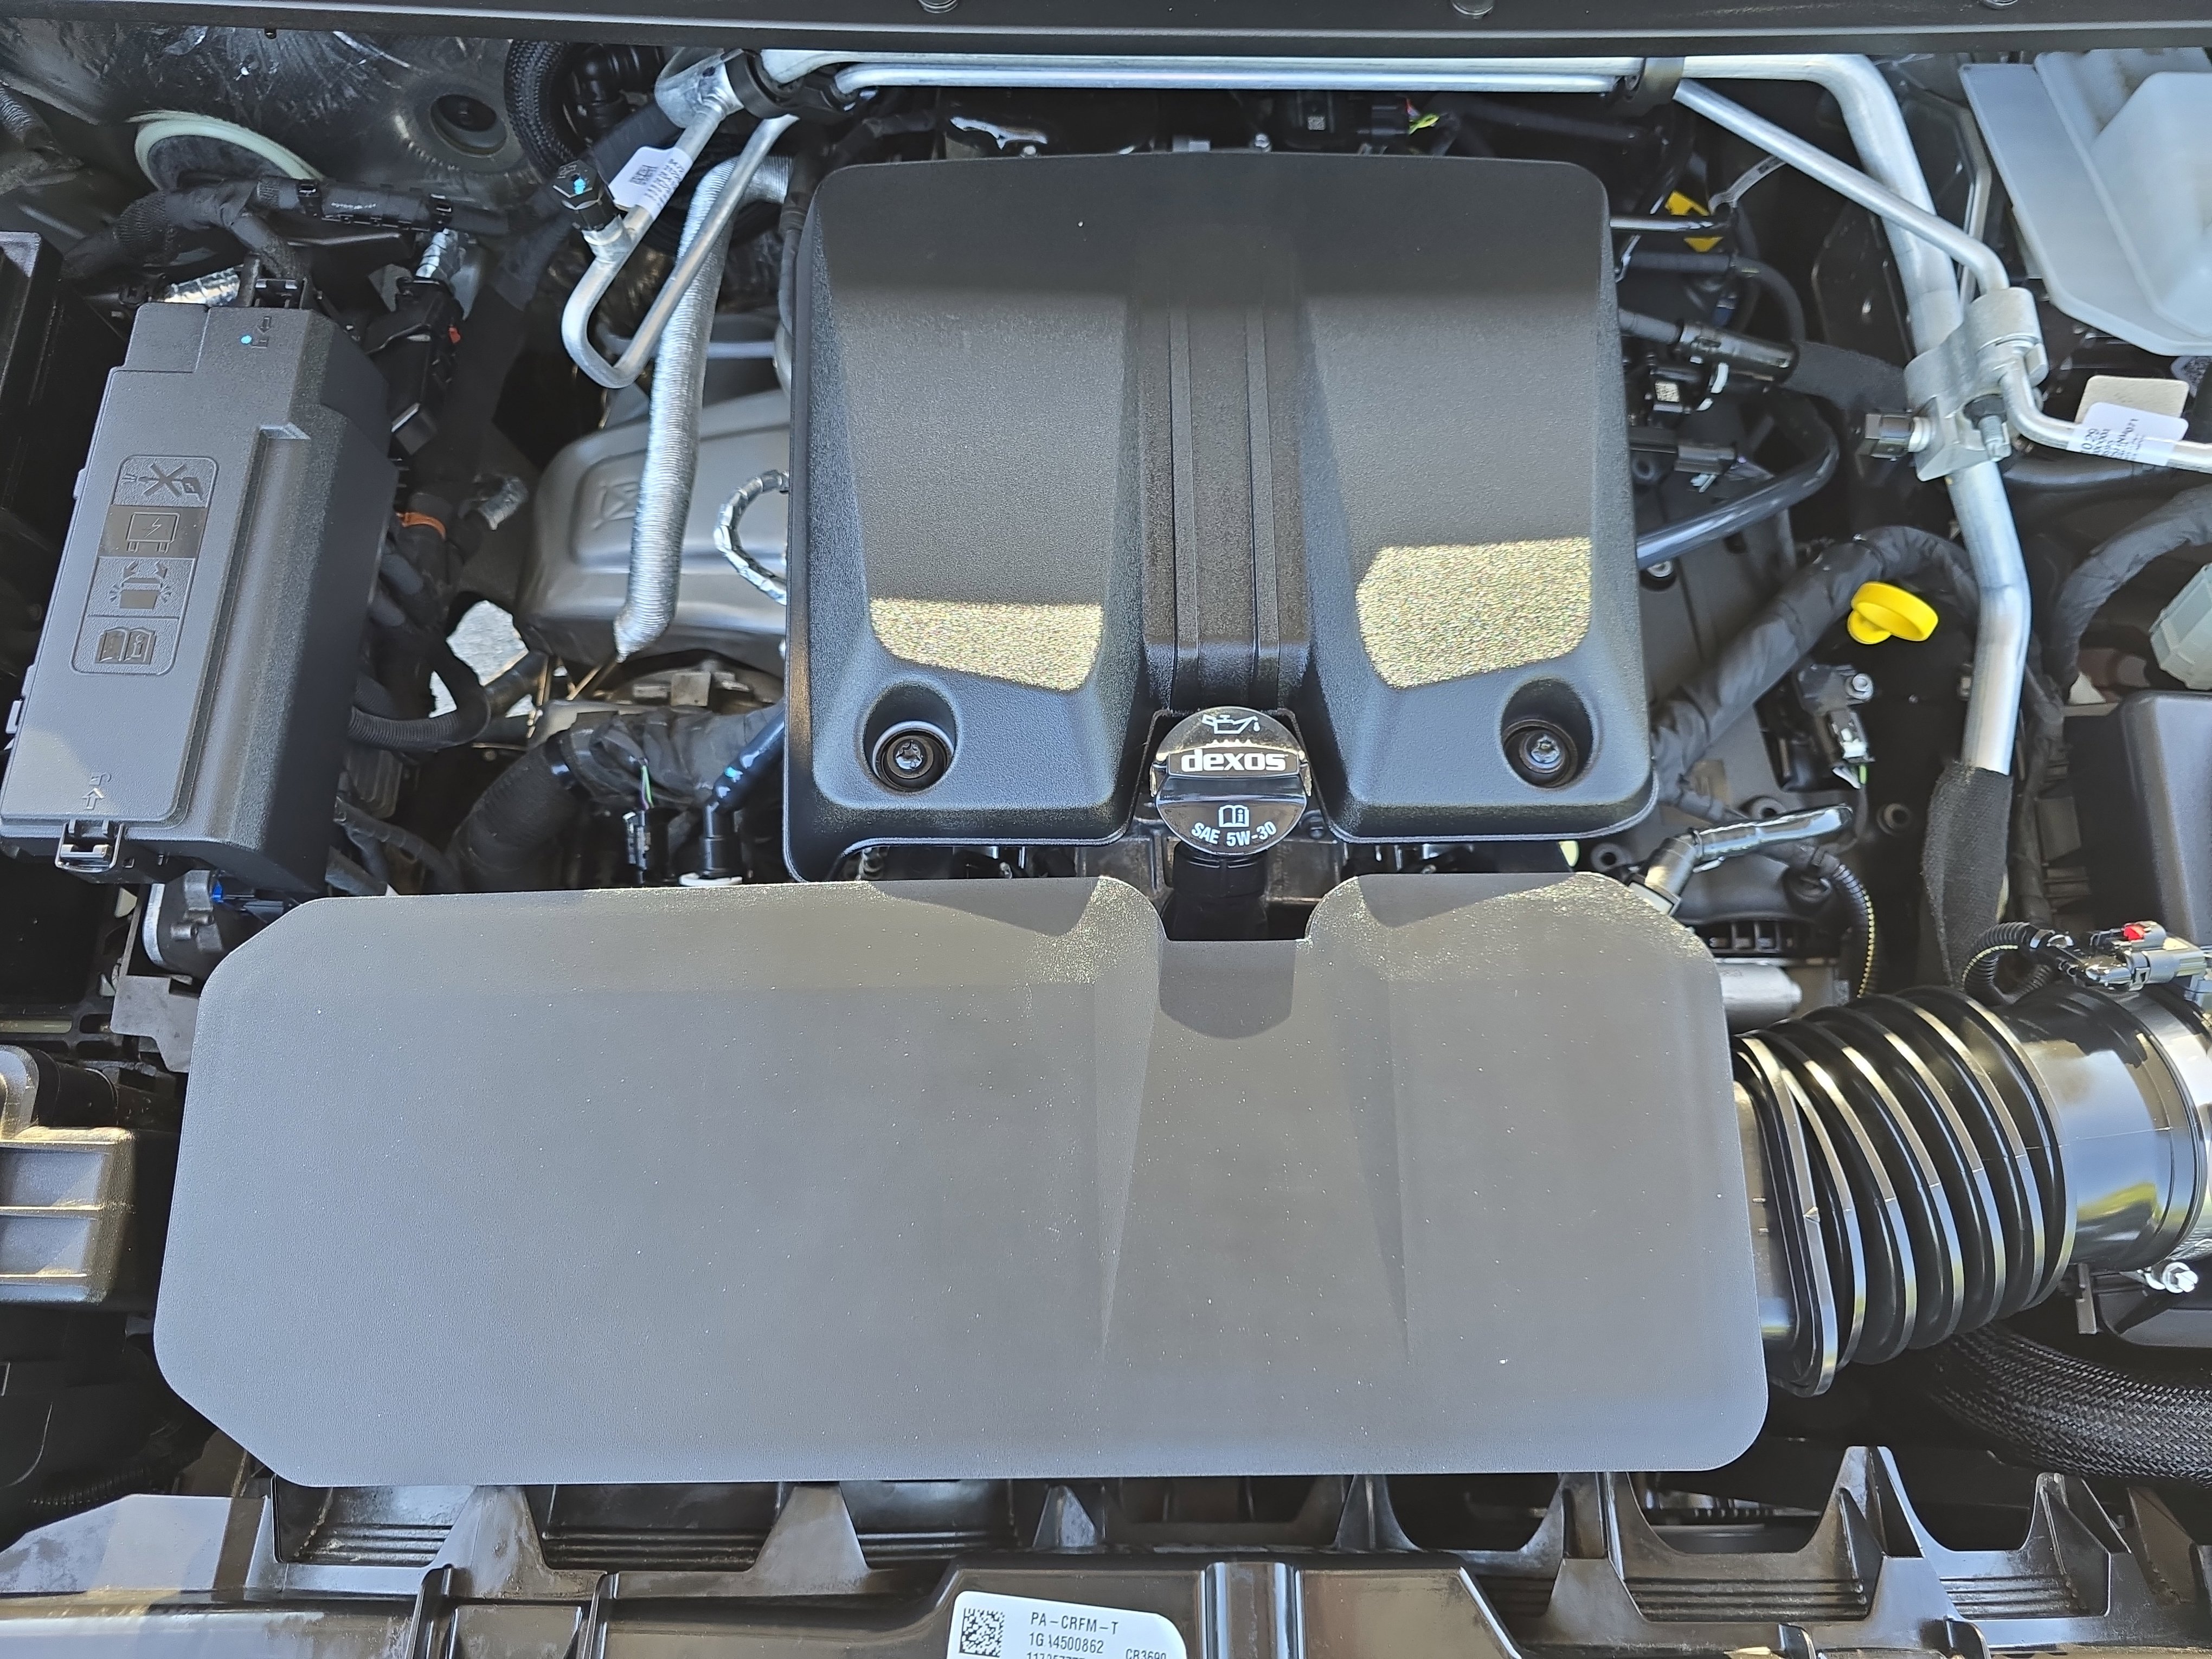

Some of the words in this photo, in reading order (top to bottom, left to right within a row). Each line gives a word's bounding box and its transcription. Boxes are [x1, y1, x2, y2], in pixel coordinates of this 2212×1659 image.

[1181, 749, 1286, 772] dexos
[1192, 822, 1221, 845] SAE
[1226, 821, 1277, 847] 5W-30
